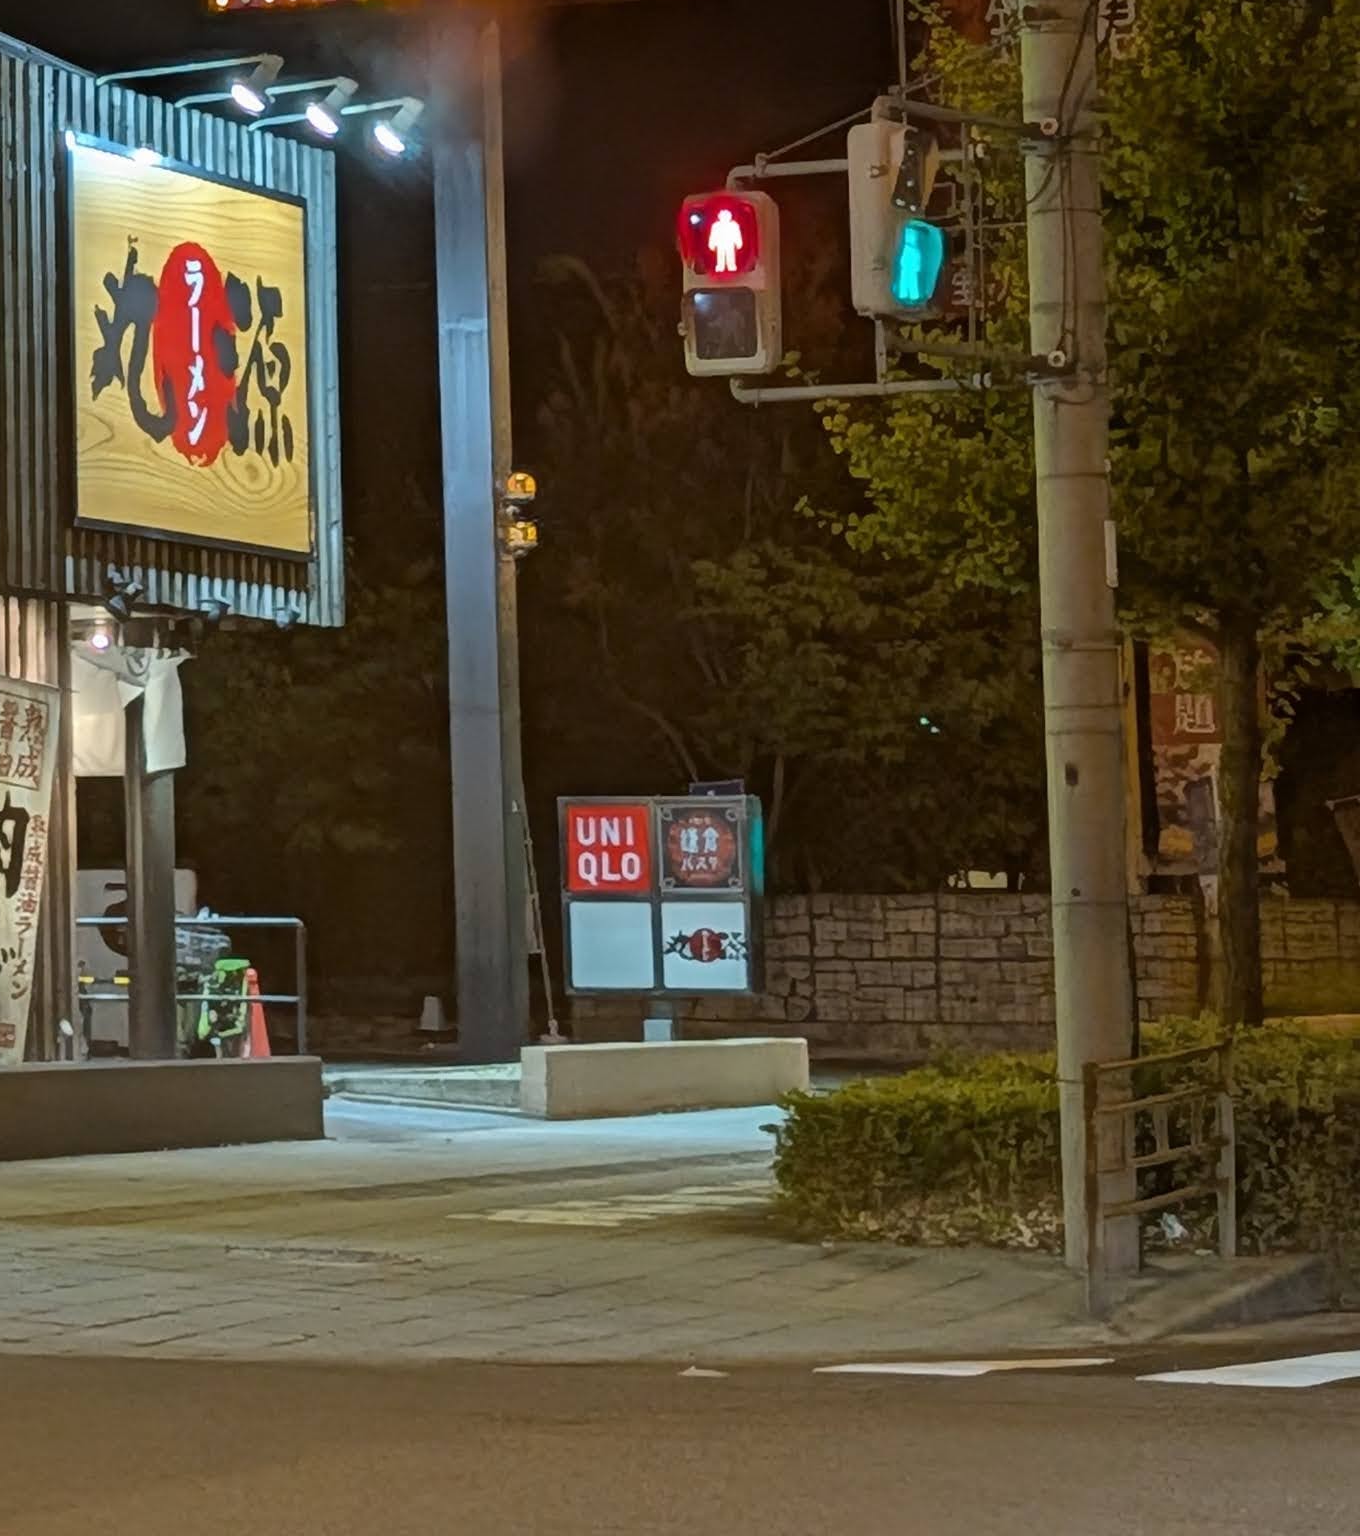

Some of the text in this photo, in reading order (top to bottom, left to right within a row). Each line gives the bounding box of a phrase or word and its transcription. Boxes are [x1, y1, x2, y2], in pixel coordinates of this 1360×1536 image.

[184, 259, 205, 446] ラーメン
[576, 816, 634, 846] UNI
[577, 851, 640, 886] QLO
